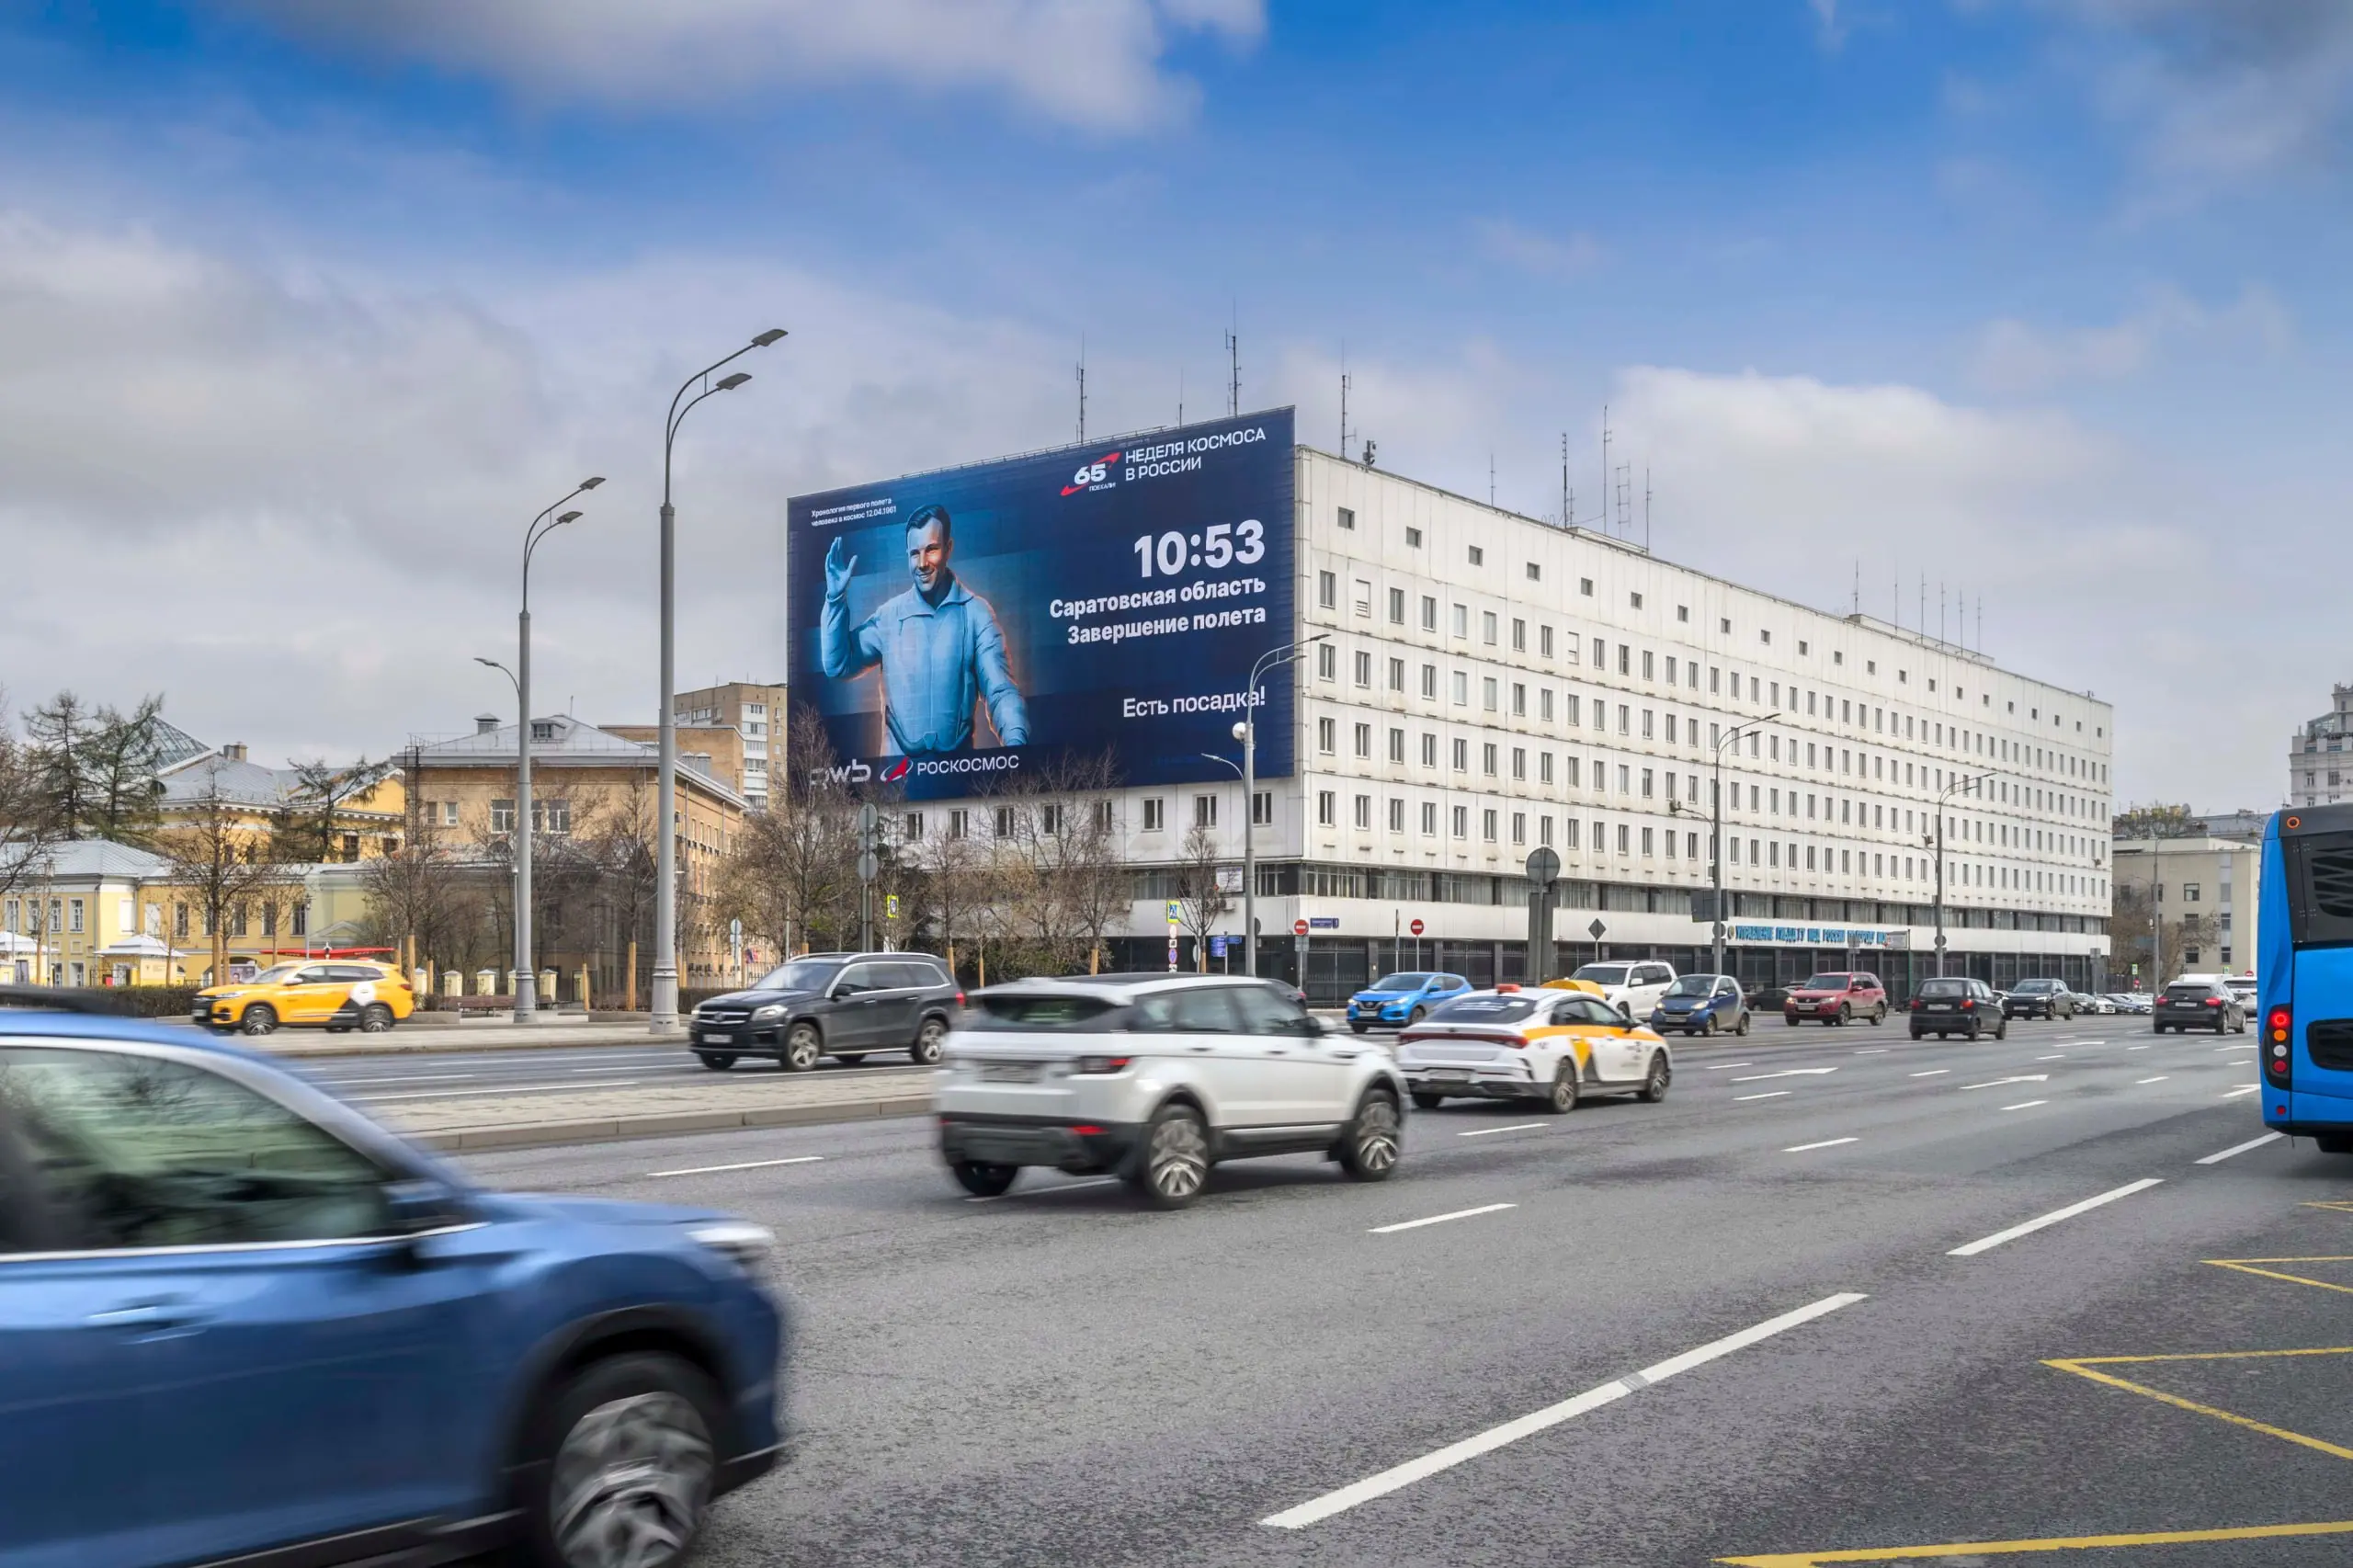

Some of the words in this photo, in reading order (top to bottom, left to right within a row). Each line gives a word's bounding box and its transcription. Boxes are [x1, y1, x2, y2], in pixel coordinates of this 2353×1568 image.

[1125, 441, 1185, 464] НЕДЕЛЯ
[1187, 426, 1267, 453] КОСМОСА
[1074, 462, 1107, 485] 65
[1125, 467, 1136, 482] В
[1138, 456, 1201, 479] РОССИИ
[812, 506, 846, 517] Хронология
[847, 502, 870, 511] первого
[871, 498, 892, 506] полета
[812, 517, 837, 526] человека
[844, 512, 865, 521] космос
[866, 506, 897, 517] 12.04.1961
[1134, 518, 1266, 578] 10:53
[1050, 587, 1176, 620] Саратовская
[1180, 576, 1267, 602] область
[1067, 615, 1189, 645] Завершение
[1193, 607, 1267, 631] полета
[1123, 697, 1169, 718] Есть
[1173, 685, 1266, 713] посадка!
[917, 755, 1020, 776] РОСКОСМОС
